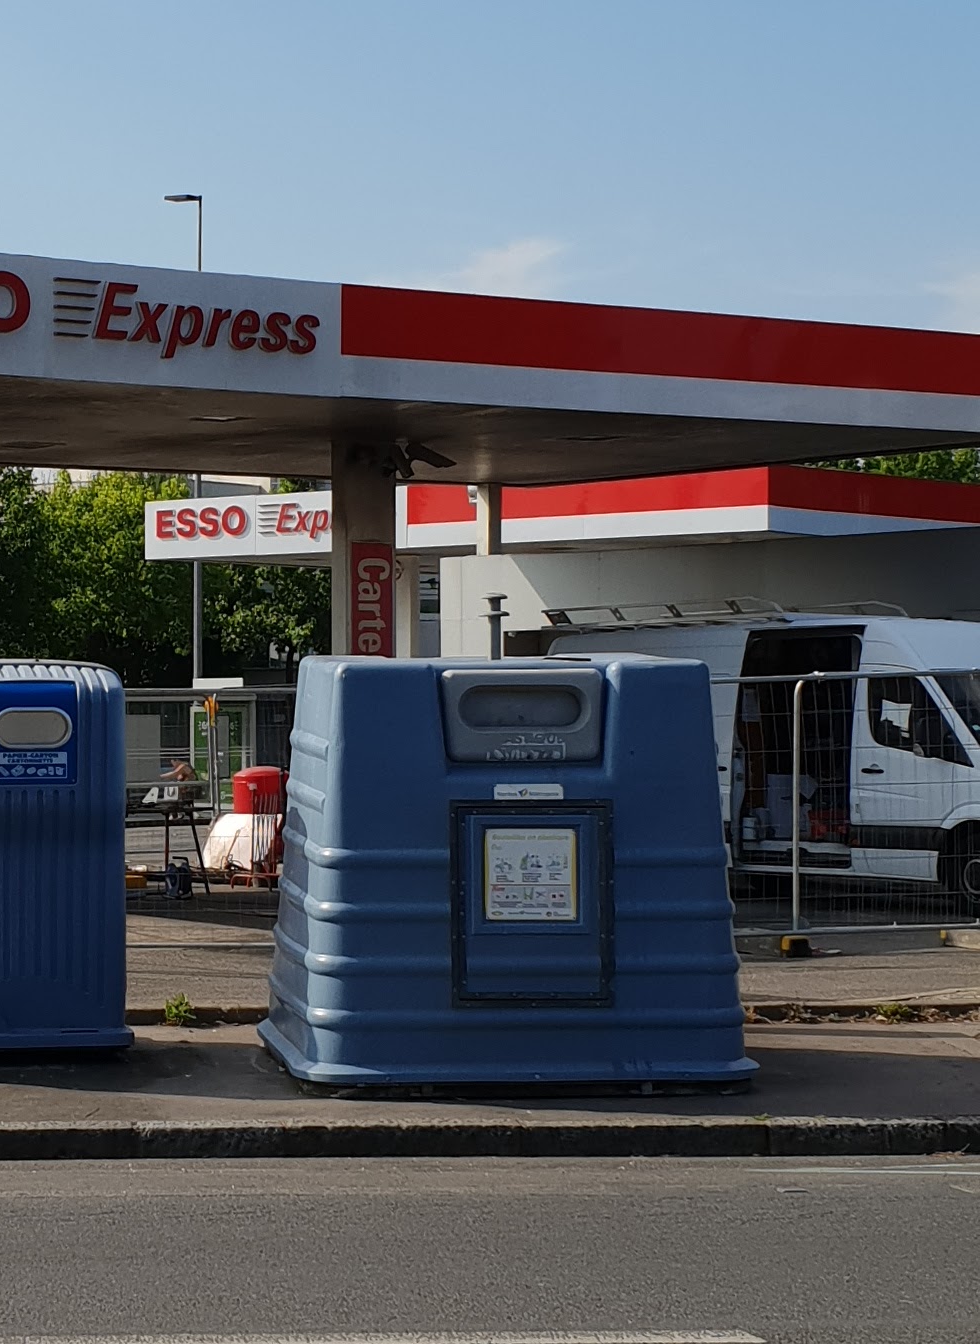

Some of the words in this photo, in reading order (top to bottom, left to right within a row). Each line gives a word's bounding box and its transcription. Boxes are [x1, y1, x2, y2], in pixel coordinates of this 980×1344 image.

[92, 280, 321, 359] Express
[155, 505, 248, 540] ESSO
[275, 502, 332, 540] Exp
